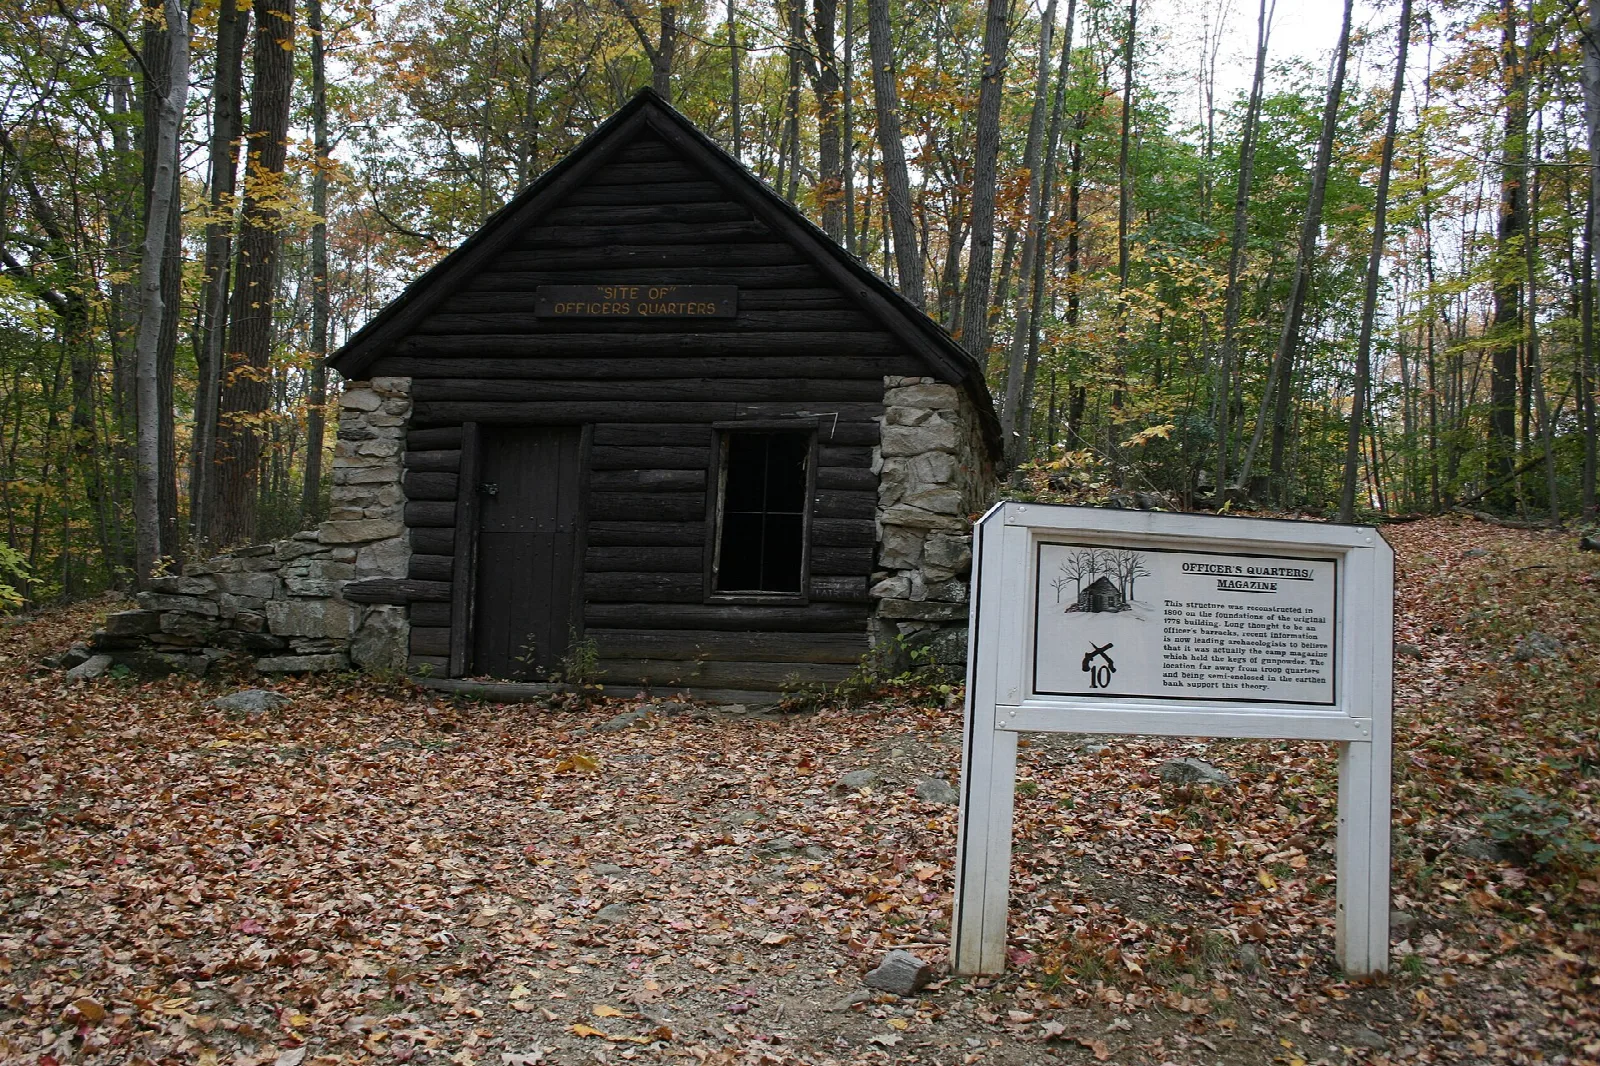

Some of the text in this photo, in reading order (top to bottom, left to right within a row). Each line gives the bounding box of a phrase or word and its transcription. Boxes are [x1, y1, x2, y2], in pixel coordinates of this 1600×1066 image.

[555, 303, 715, 315] OFFICERS QUARTERS
[1182, 563, 1313, 578] OFFICER'S QUARTERS/
[1217, 580, 1277, 590] MAGAZINE
[1247, 605, 1302, 613] reconstructed
[1215, 611, 1263, 620] foundations
[1224, 621, 1244, 629] Long
[1248, 622, 1279, 630] thought
[1271, 631, 1318, 639] information
[1194, 637, 1224, 645] leading
[1228, 639, 1286, 648] archaeologists
[1213, 647, 1246, 656] actually
[1266, 650, 1286, 658] camp
[1228, 656, 1246, 664] kegs
[1285, 667, 1319, 675] quarters
[1089, 665, 1111, 688] 10
[1182, 672, 1204, 680] being
[1241, 683, 1270, 691] theory.
